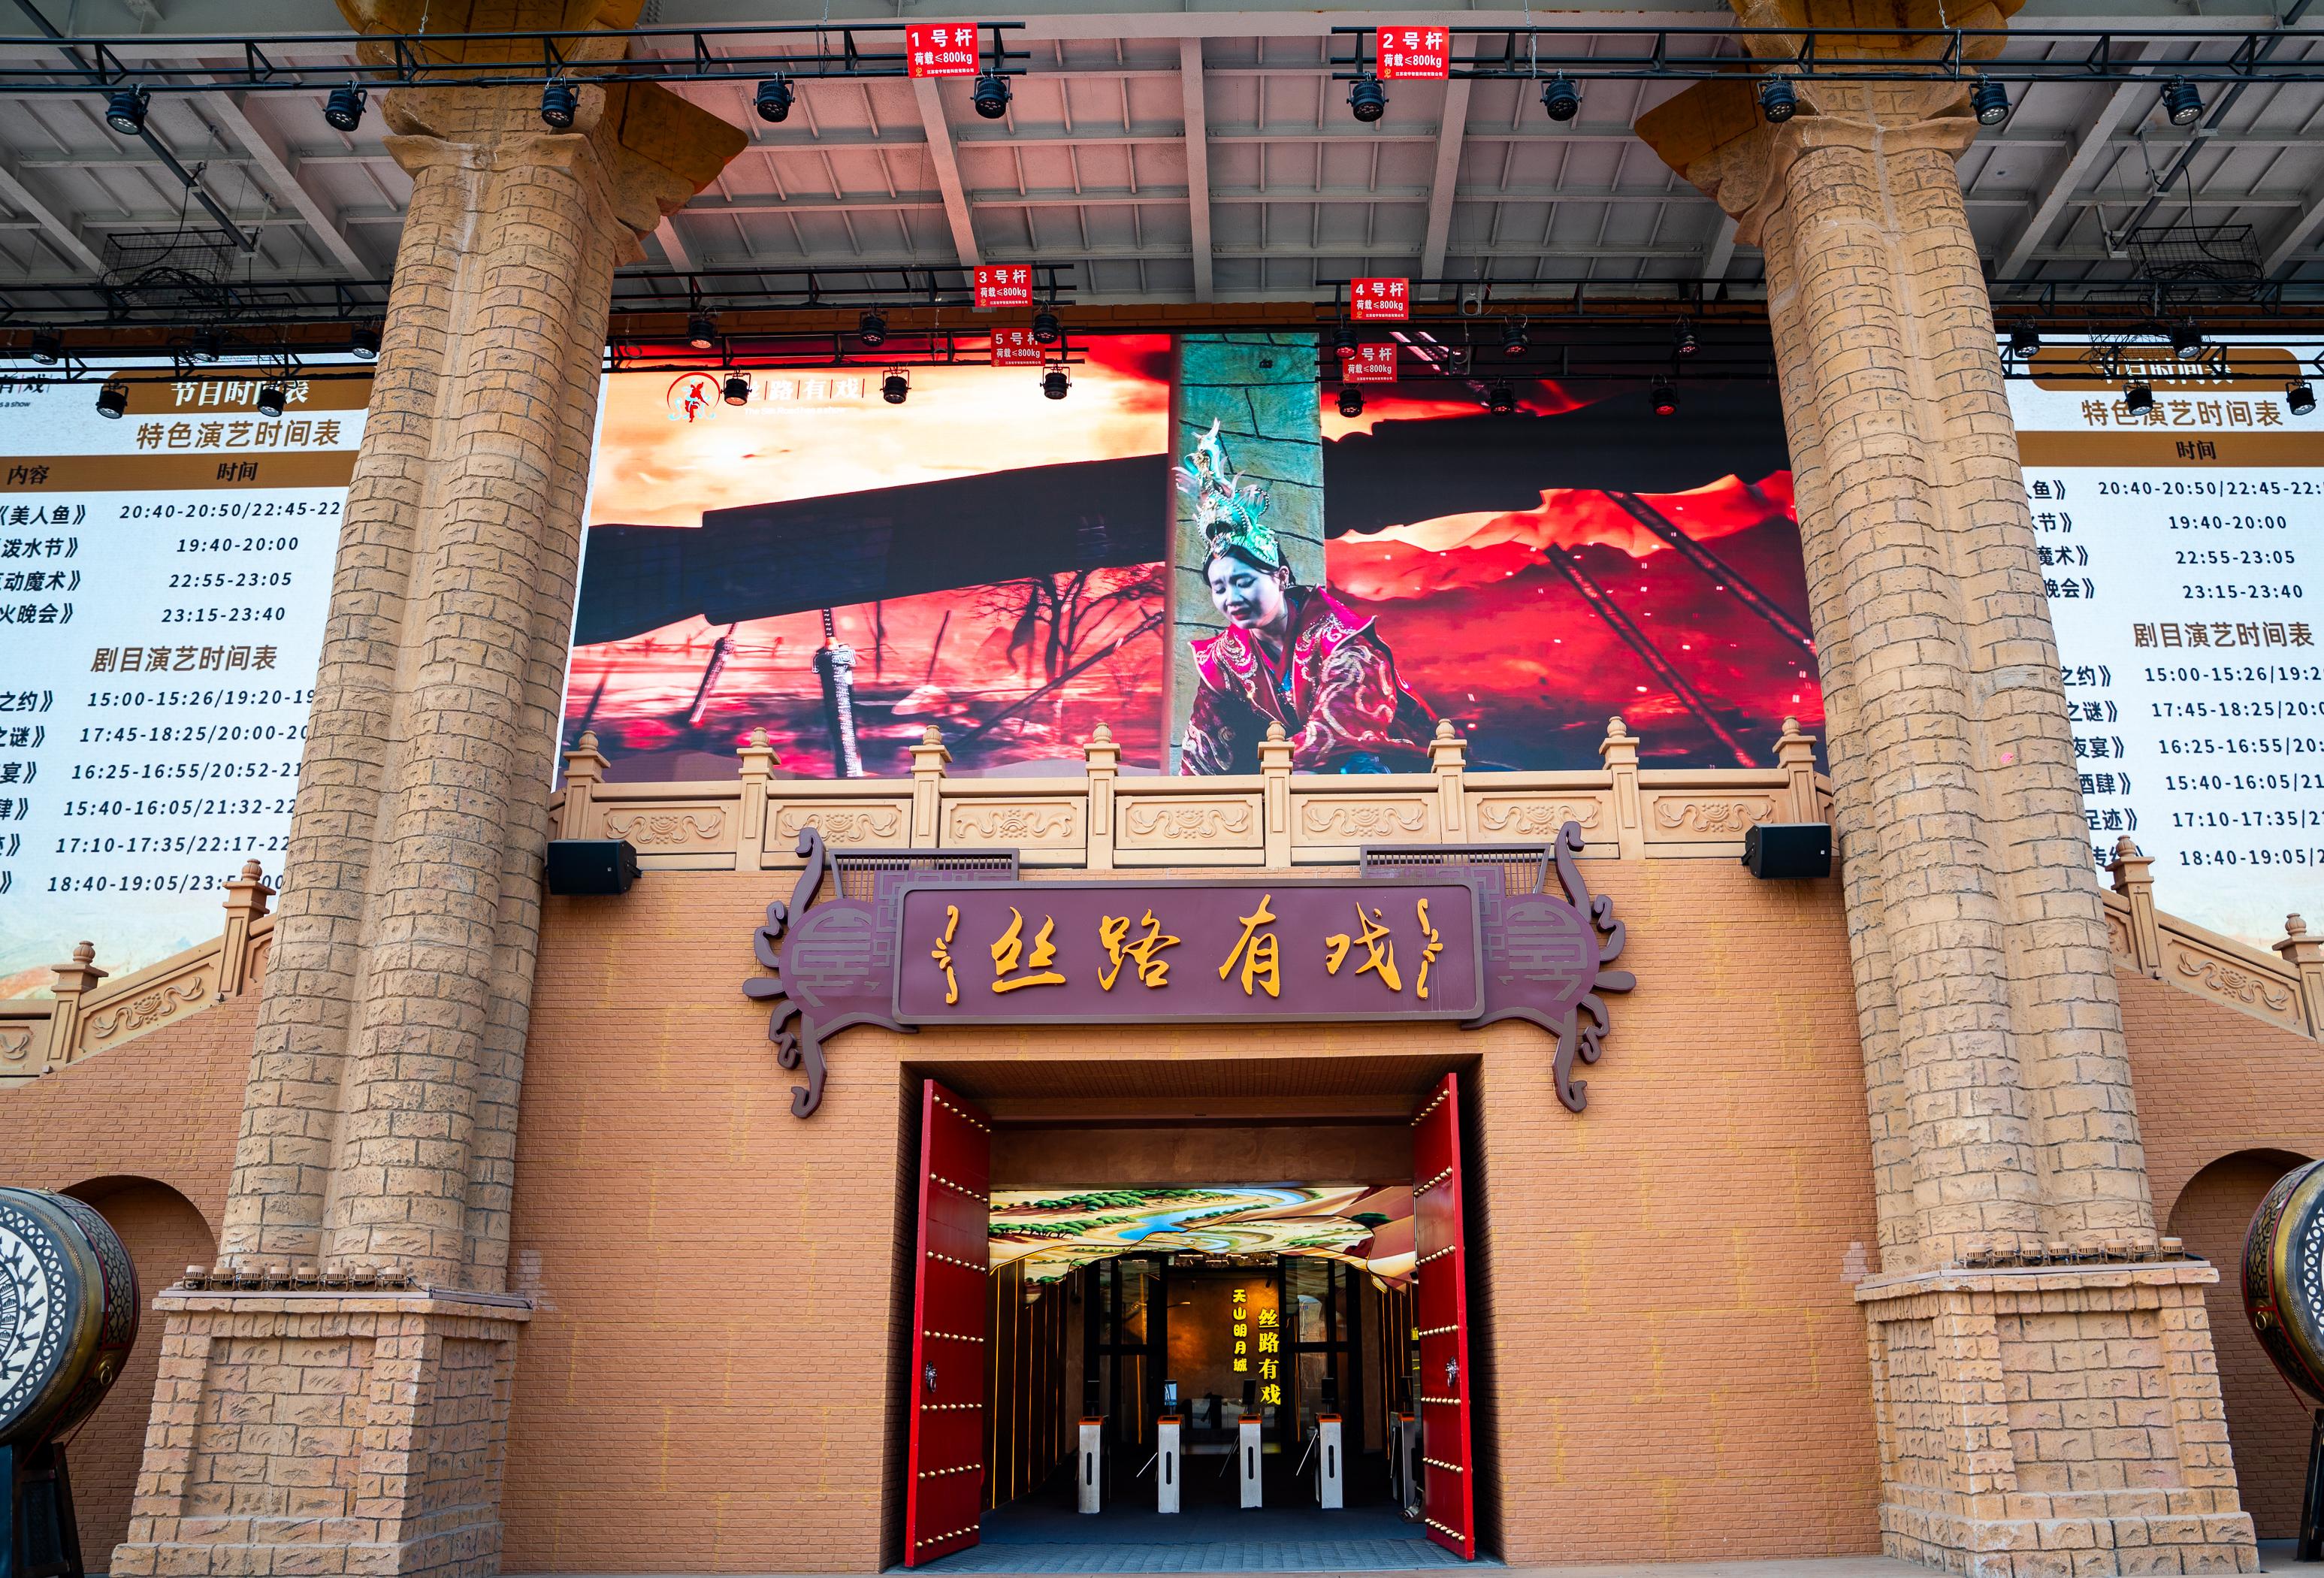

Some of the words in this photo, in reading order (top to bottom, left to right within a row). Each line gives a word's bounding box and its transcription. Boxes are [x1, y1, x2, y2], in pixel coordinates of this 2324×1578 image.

[911, 28, 972, 47] 1号杆
[1383, 32, 1443, 50] 2号杆
[914, 51, 972, 65] 荷载≤800kg
[1384, 53, 1442, 68] 荷载≤800kg
[979, 269, 1026, 284] 3号杆
[980, 287, 1026, 298] 荷载≤800kg
[1355, 283, 1404, 296] 4号杆
[1357, 300, 1403, 310] 荷载≤800kg
[996, 349, 1040, 358] 荷载≤800kg
[1348, 347, 1392, 361] 号杆
[1348, 364, 1392, 373] 荷载≤800kg
[2081, 399, 2283, 426] 特色演艺时间表
[137, 419, 340, 449] 特色演艺时间表
[2176, 440, 2216, 460] 时间
[8, 465, 50, 485] 内容
[217, 461, 258, 482] 时间
[2026, 480, 2065, 500] 鱼》
[2169, 516, 2286, 528] 19:40-20:00
[0, 537, 77, 558] 泼水节》
[177, 537, 298, 552] 19:40-20:00
[2176, 551, 2294, 564] 22:55-23:05
[169, 573, 291, 587] 22:55-23:05
[2183, 585, 2302, 598] 23:15-23:40
[162, 607, 285, 622] 23:15-23:40
[2134, 621, 2314, 647] 剧目演艺时间表
[90, 645, 277, 672] 剧目演艺时间表
[0, 762, 36, 784] 宴》
[990, 894, 1403, 998] 丝路有戏
[1232, 1289, 1247, 1372] 天山明月城
[1258, 1308, 1281, 1405] 丝路有戏
